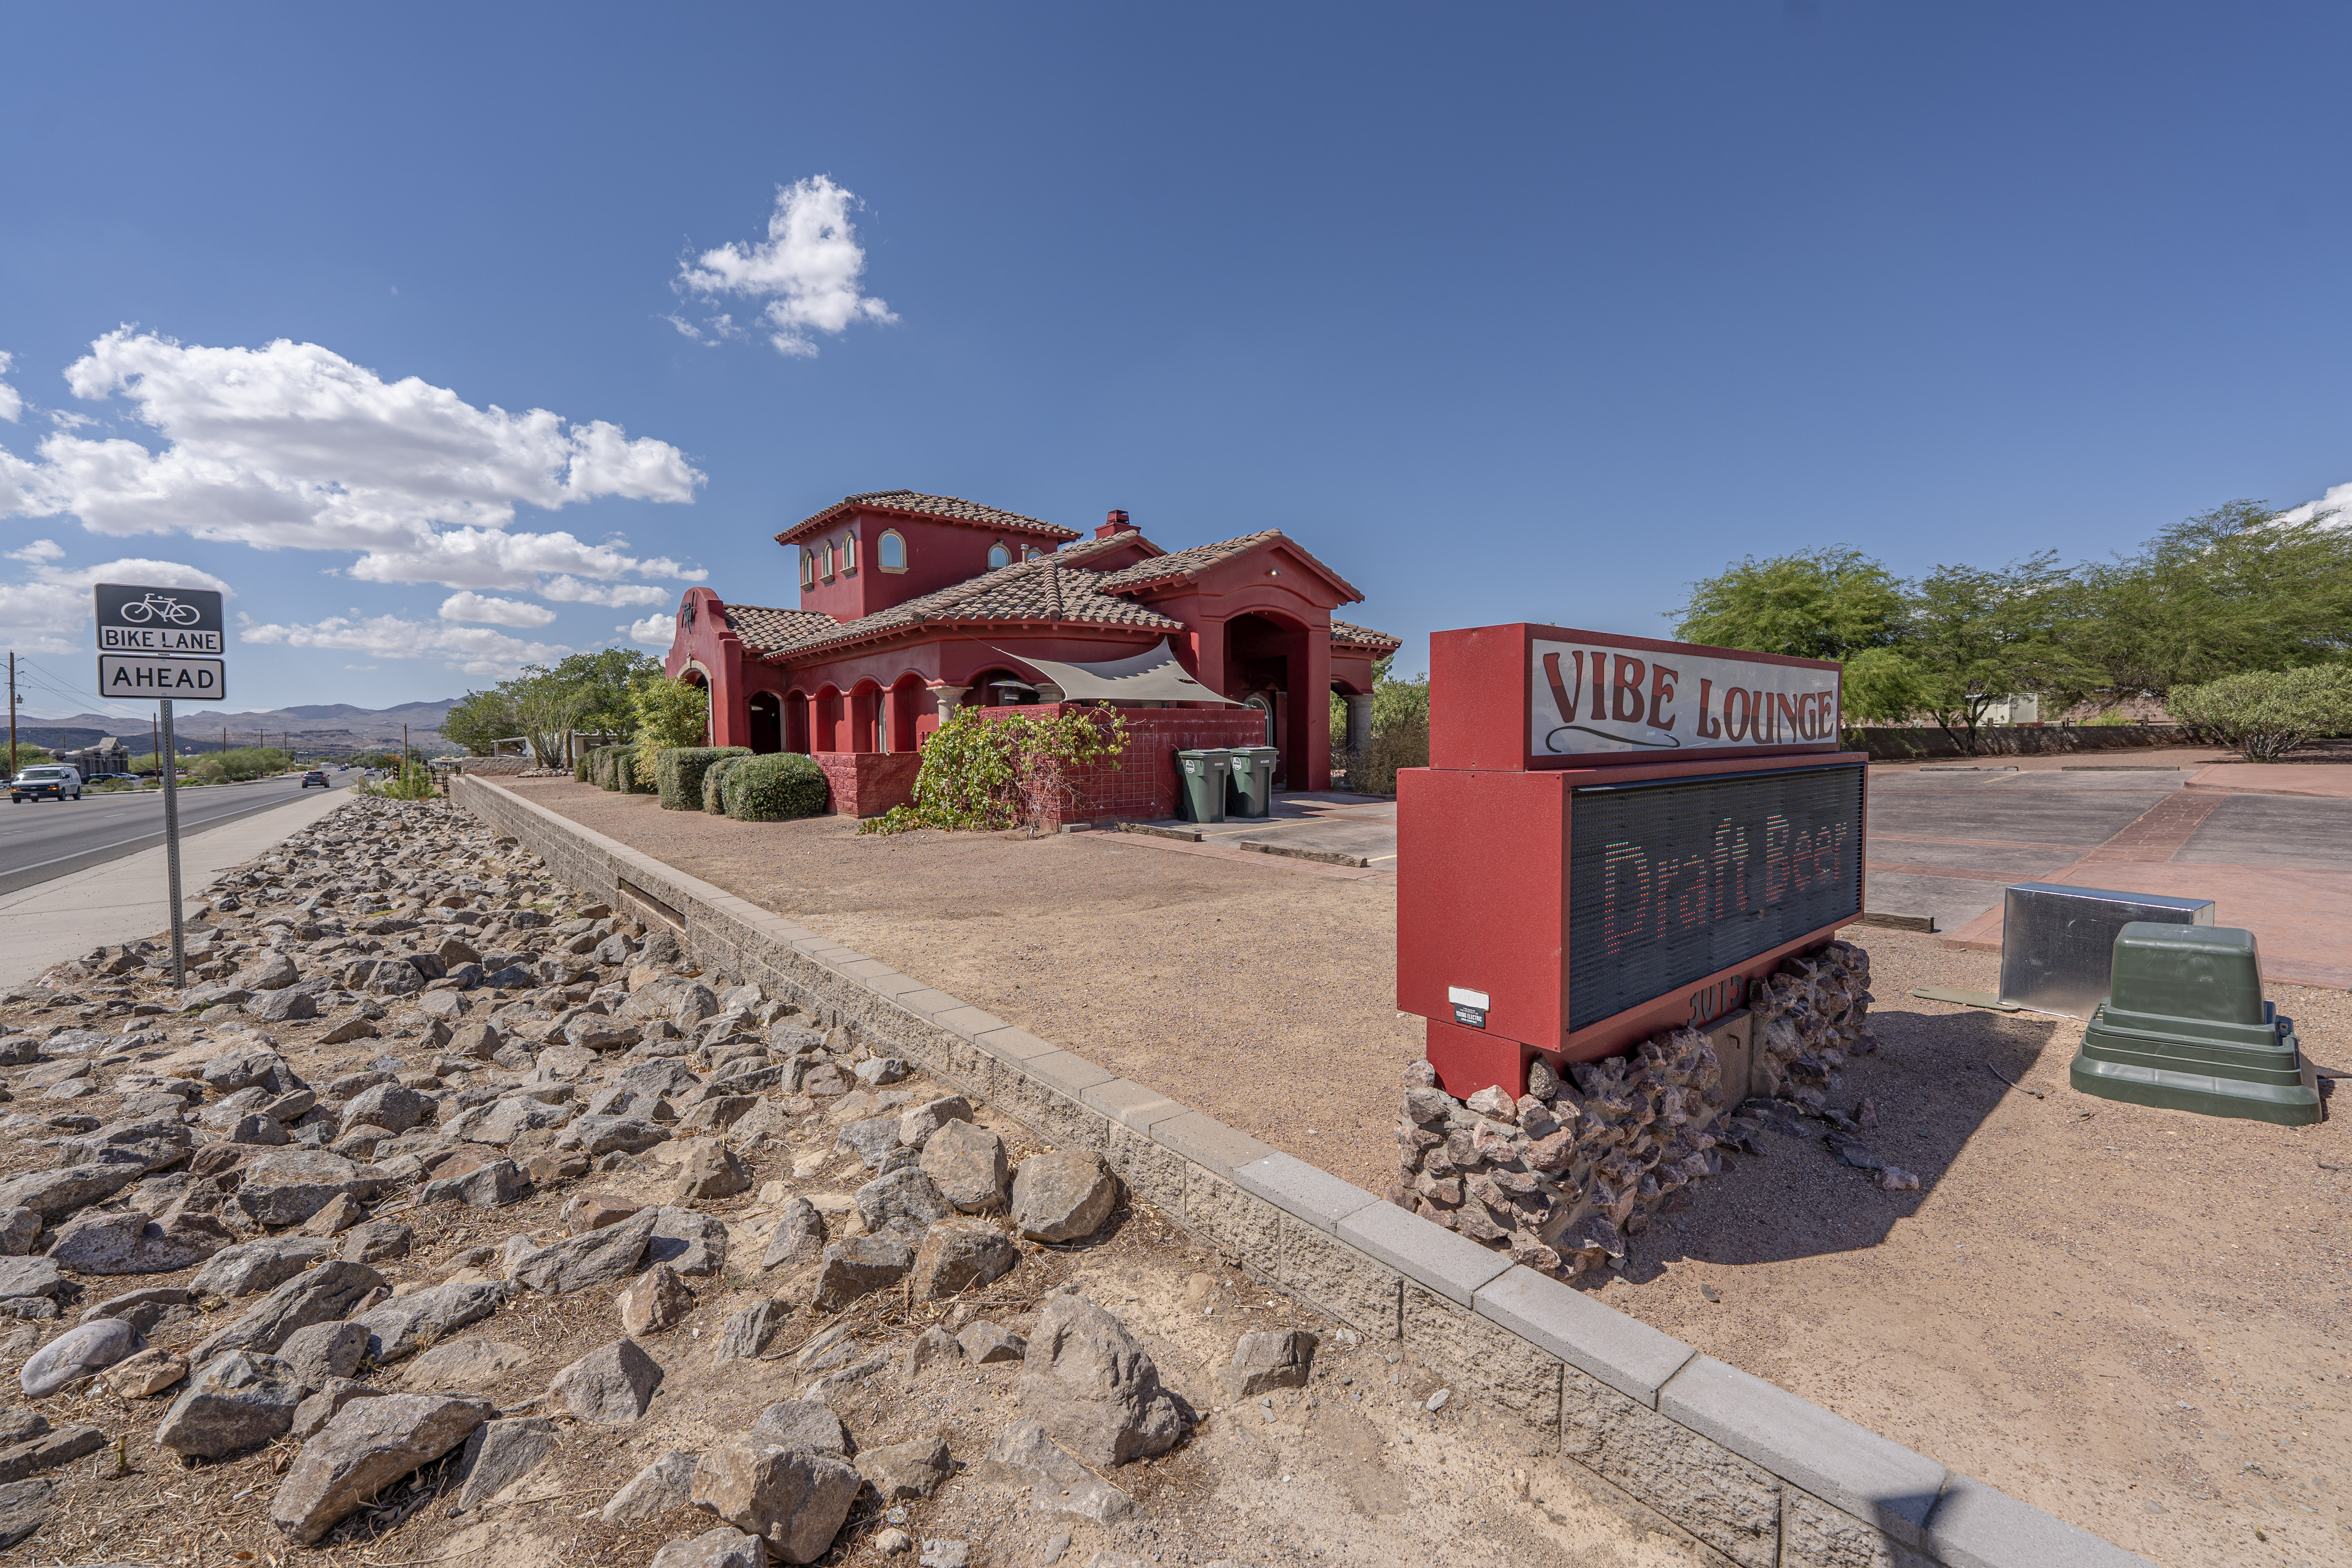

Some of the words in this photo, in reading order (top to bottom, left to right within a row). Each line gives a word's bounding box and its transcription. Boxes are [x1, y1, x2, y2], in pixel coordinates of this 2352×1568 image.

[105, 629, 154, 647] BIKE
[162, 632, 217, 650] LANE
[112, 666, 214, 689] AHEAD
[1543, 650, 1679, 731] VIBE
[1696, 678, 1834, 745] LOUNGE
[1605, 817, 1749, 954] Draft
[1766, 814, 1848, 902] Beer
[1467, 1013, 1482, 1022] ELECTRIC
